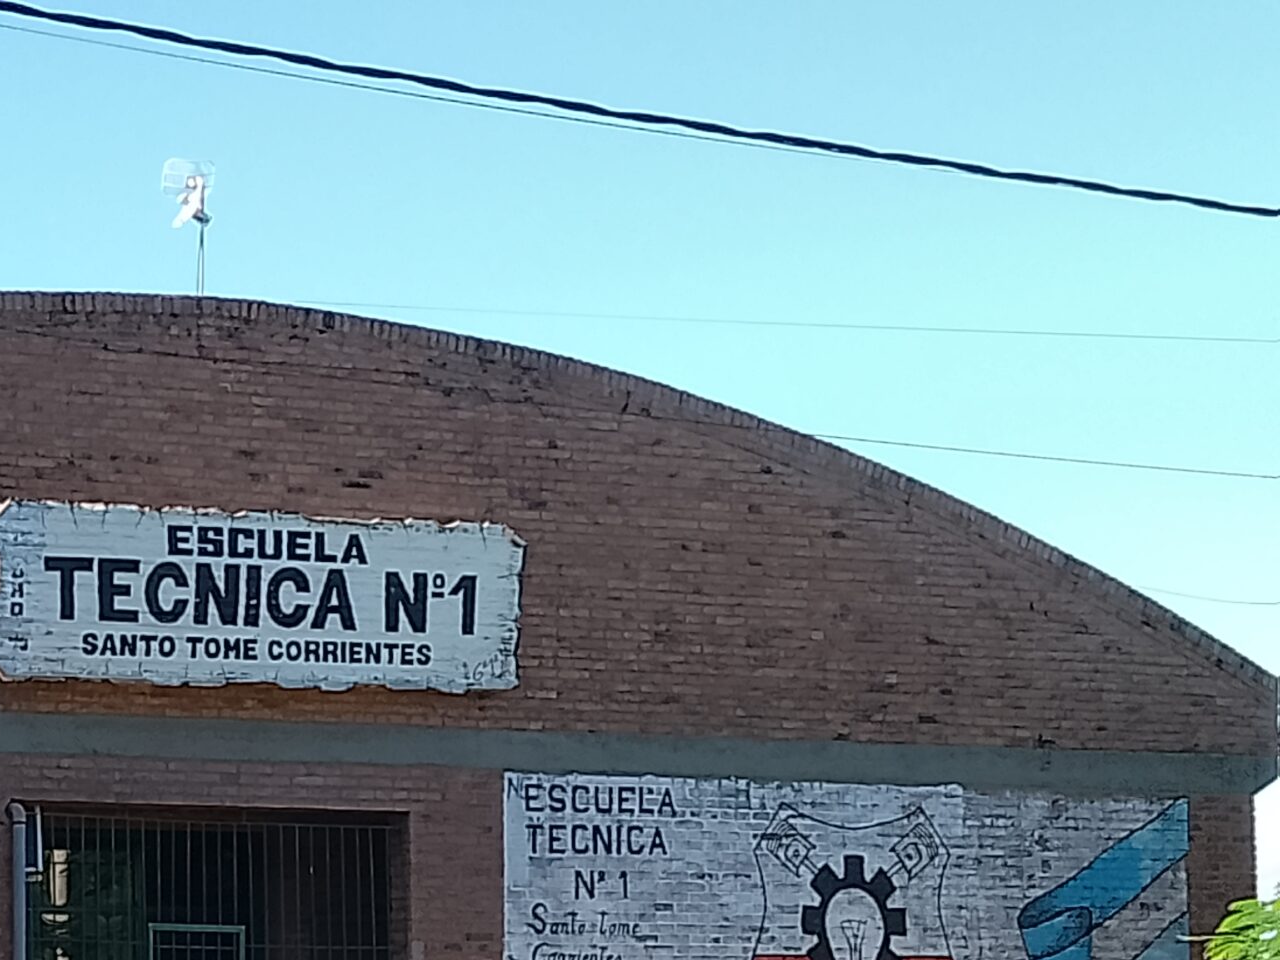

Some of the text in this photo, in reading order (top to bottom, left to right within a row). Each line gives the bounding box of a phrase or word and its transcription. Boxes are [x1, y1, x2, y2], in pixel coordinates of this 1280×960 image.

[167, 524, 368, 565] ESCUELA
[44, 556, 358, 631] TECNICA
[81, 632, 432, 665] SANTO TOME CORRIENTES
[525, 783, 677, 818] ESCUELA
[525, 823, 668, 855] TECNICA
[525, 902, 586, 935] Santo
